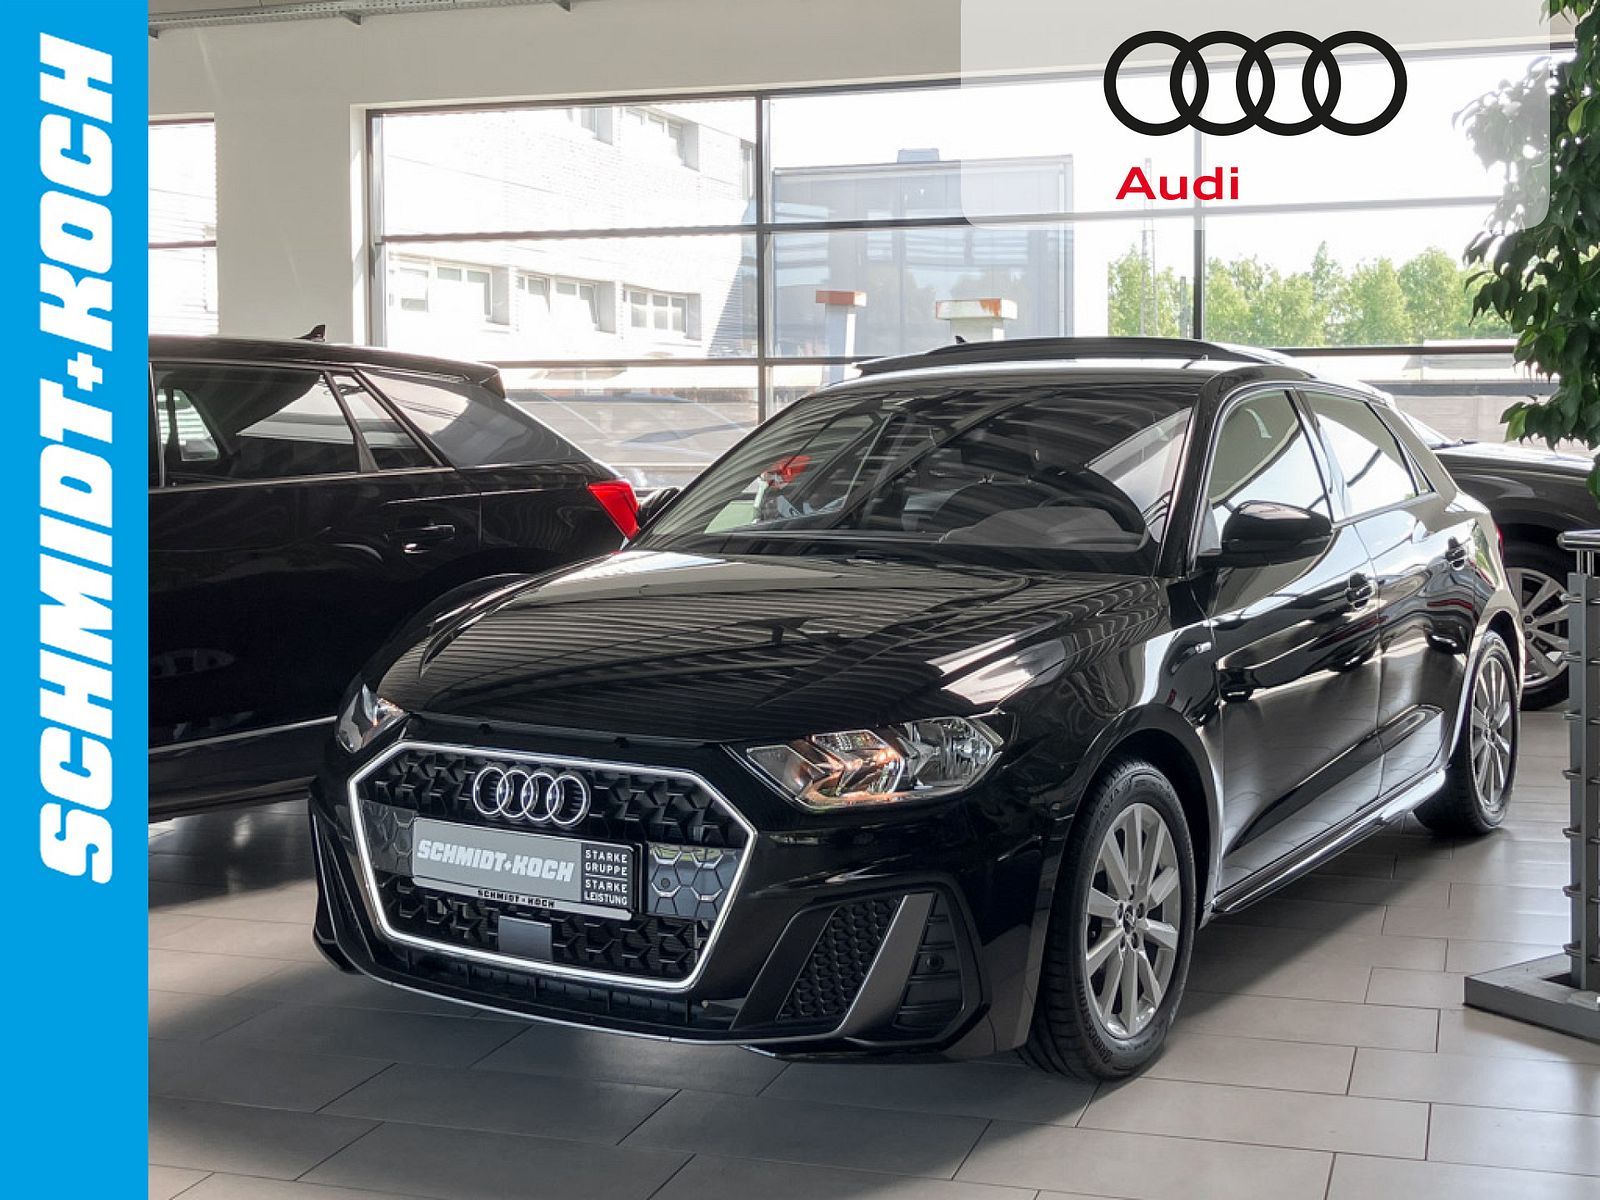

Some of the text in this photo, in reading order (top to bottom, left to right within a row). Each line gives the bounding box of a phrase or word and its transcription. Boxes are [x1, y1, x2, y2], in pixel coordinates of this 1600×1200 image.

[417, 839, 575, 882] SCHMIDT+KOCH
[585, 849, 628, 863] STARKE
[585, 862, 628, 876] GRUPPE
[585, 879, 628, 893] STARKE
[478, 890, 520, 903] SCHMIDT
[584, 891, 628, 906] LEISTUNG
